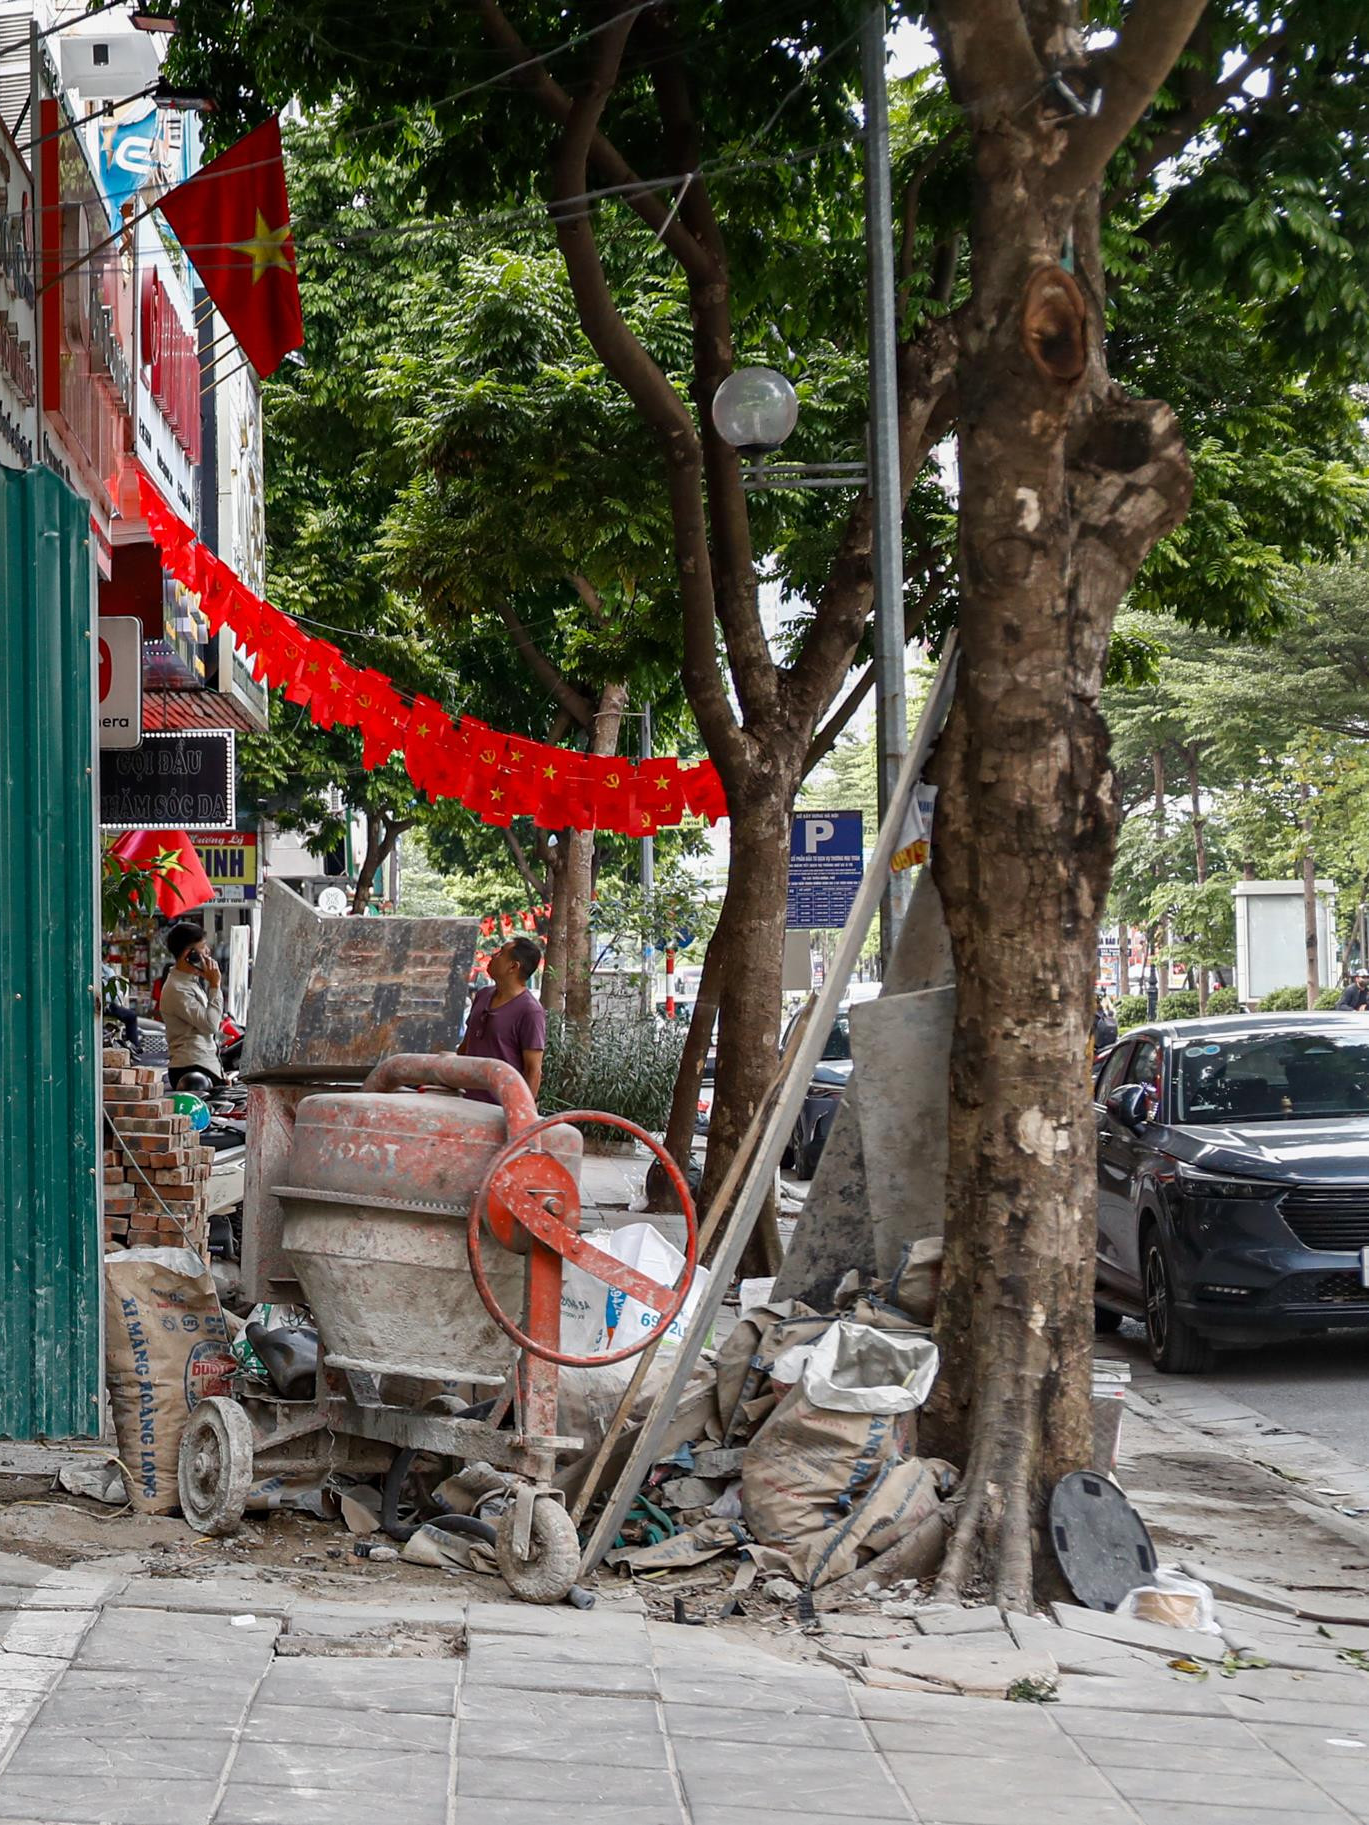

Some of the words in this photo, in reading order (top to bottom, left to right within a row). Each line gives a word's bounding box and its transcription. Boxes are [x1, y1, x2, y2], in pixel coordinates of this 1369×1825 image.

[197, 793, 227, 819] DA
[805, 820, 834, 853] P
[121, 1296, 139, 1317] XI
[126, 1320, 153, 1377] MĂNG
[138, 1381, 159, 1446] HOÀNG
[140, 1450, 159, 1499] LONG
